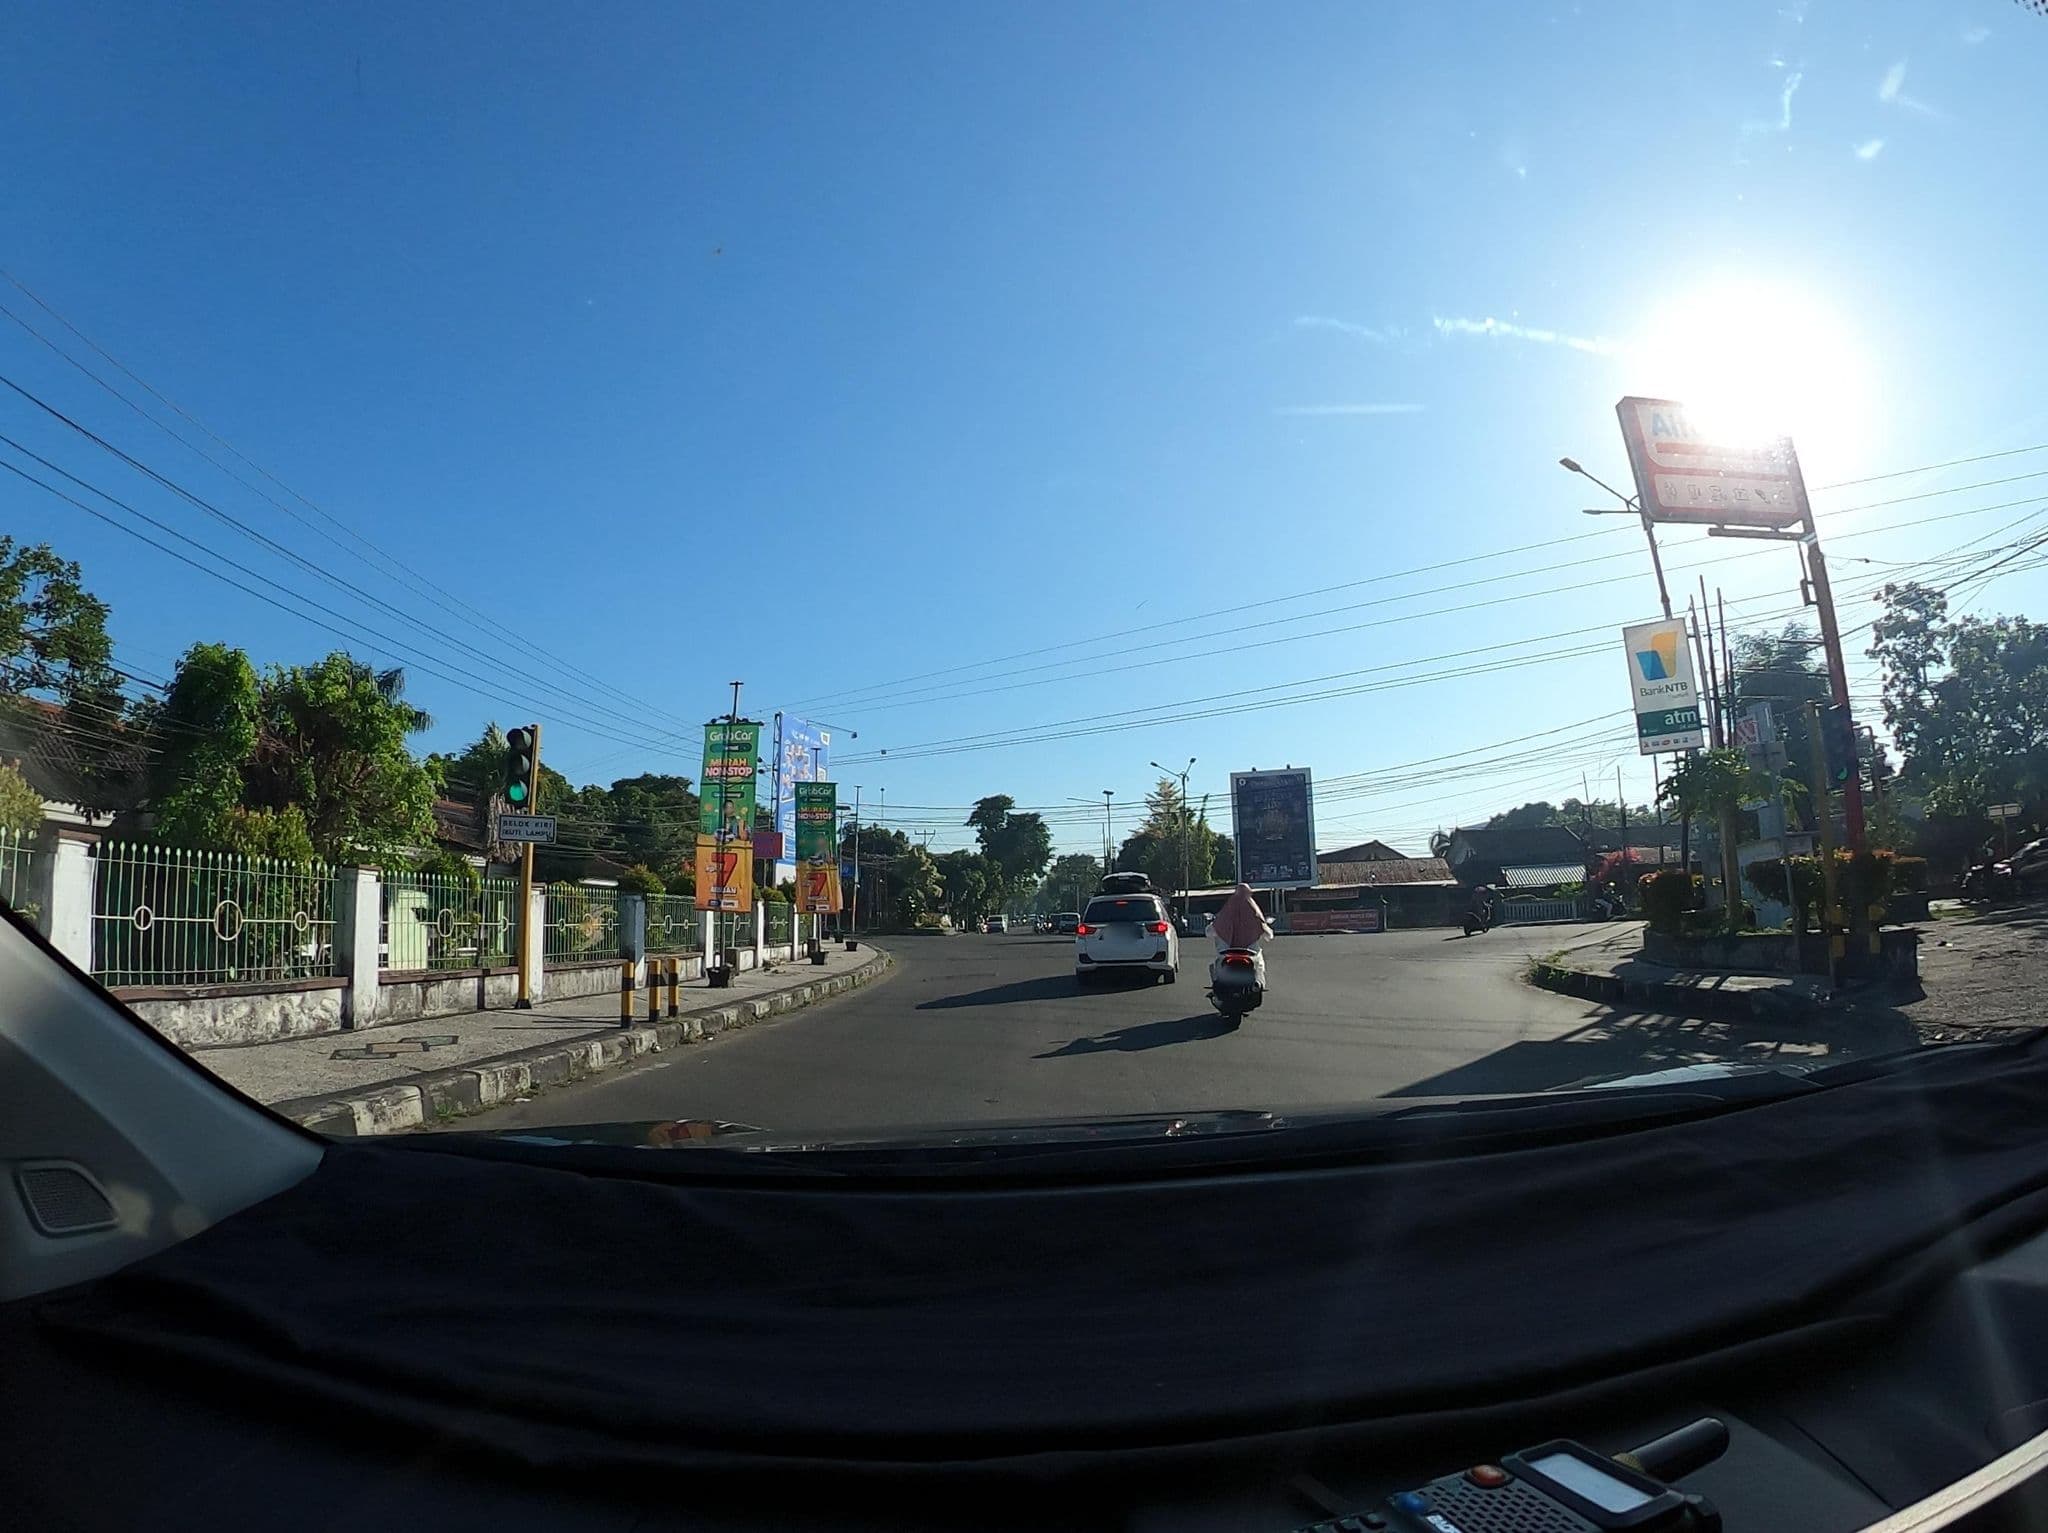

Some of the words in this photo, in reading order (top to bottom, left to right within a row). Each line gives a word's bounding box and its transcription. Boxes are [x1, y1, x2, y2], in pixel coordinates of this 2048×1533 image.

[1640, 682, 1688, 697] BankNTB
[1664, 710, 1697, 725] atm
[502, 820, 529, 828] BELOK
